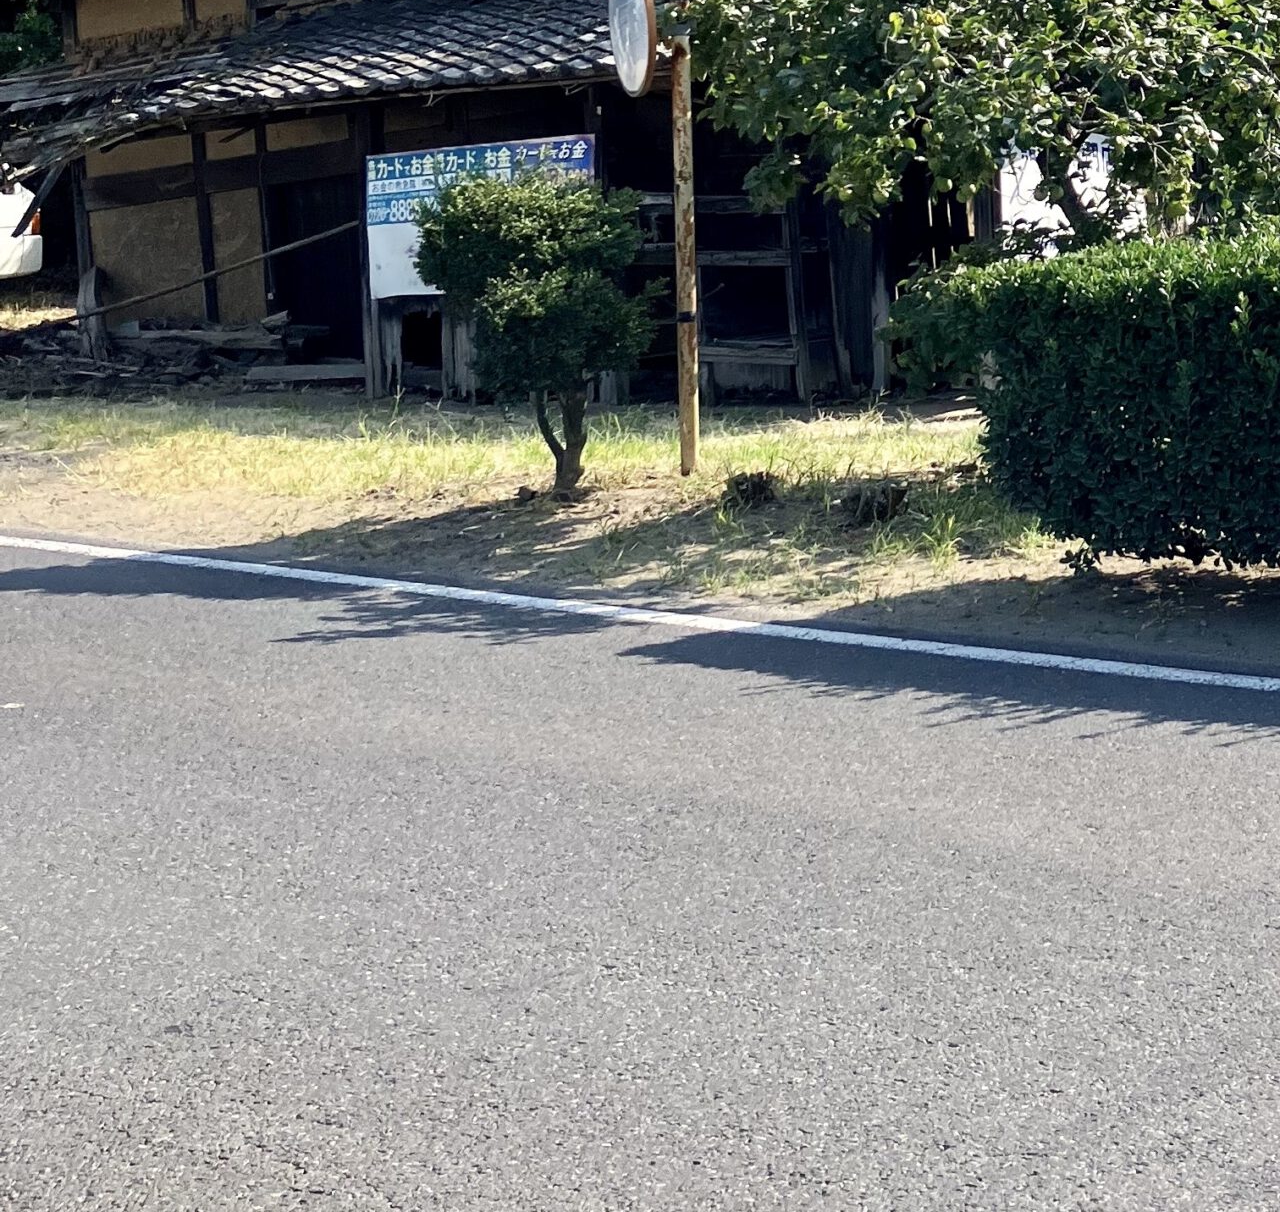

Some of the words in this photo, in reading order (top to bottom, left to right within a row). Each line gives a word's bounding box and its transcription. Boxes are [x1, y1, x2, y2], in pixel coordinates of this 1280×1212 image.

[446, 147, 512, 172] カードお金
